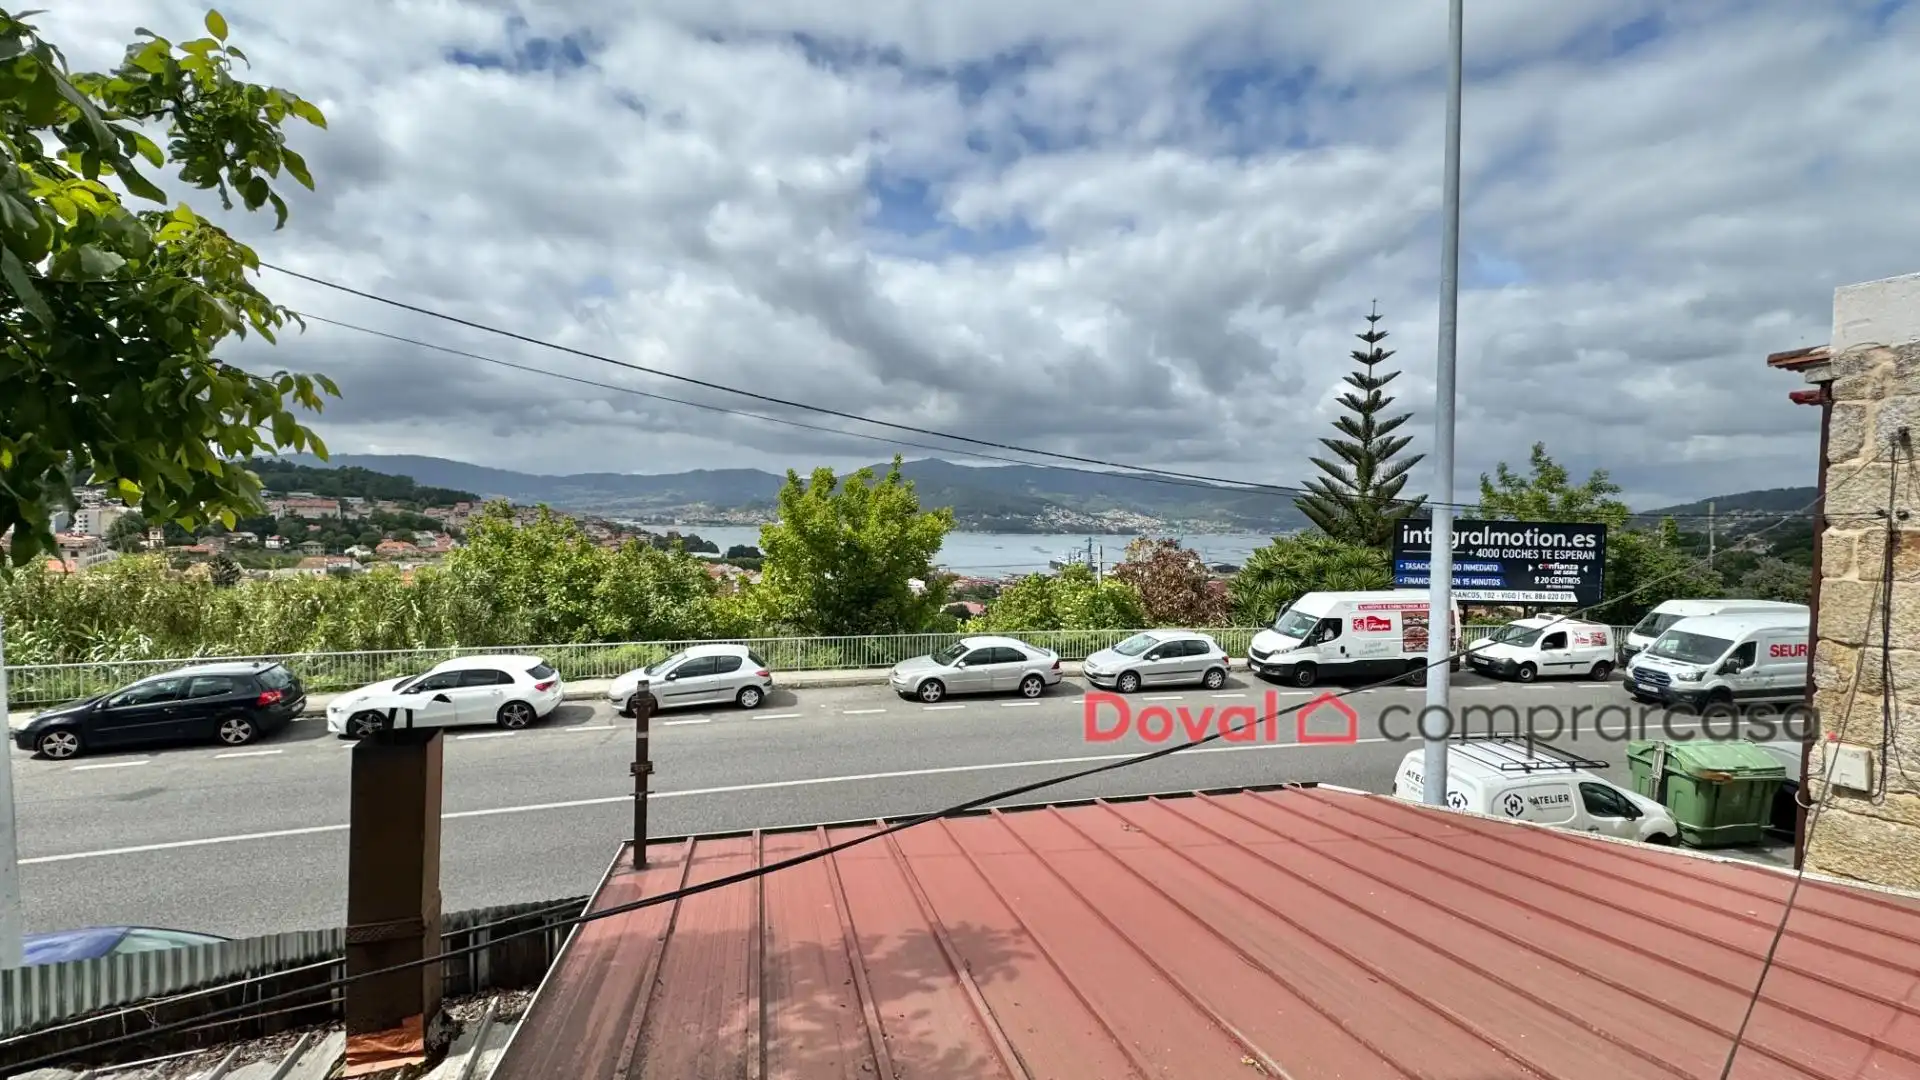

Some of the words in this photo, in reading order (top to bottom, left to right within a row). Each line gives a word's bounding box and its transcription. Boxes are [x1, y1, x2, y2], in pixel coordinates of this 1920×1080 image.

[1403, 525, 1596, 549] intgralmotion.es
[1476, 549, 1500, 559] 4000
[1502, 549, 1539, 559] COCHES
[1541, 550, 1553, 560] TE
[1554, 550, 1596, 560] ESPERAN
[1463, 563, 1498, 572] INMEDIATO
[1538, 562, 1579, 570] confianza
[1452, 577, 1461, 585] EN
[1471, 578, 1501, 586] MINUTOS
[1540, 576, 1550, 584] 20
[1550, 576, 1581, 585] CENTROS
[1501, 591, 1516, 599] VIGO
[1769, 643, 1808, 658] SEUR
[1405, 769, 1425, 786] ATEL
[1532, 793, 1570, 805] ATELIER
